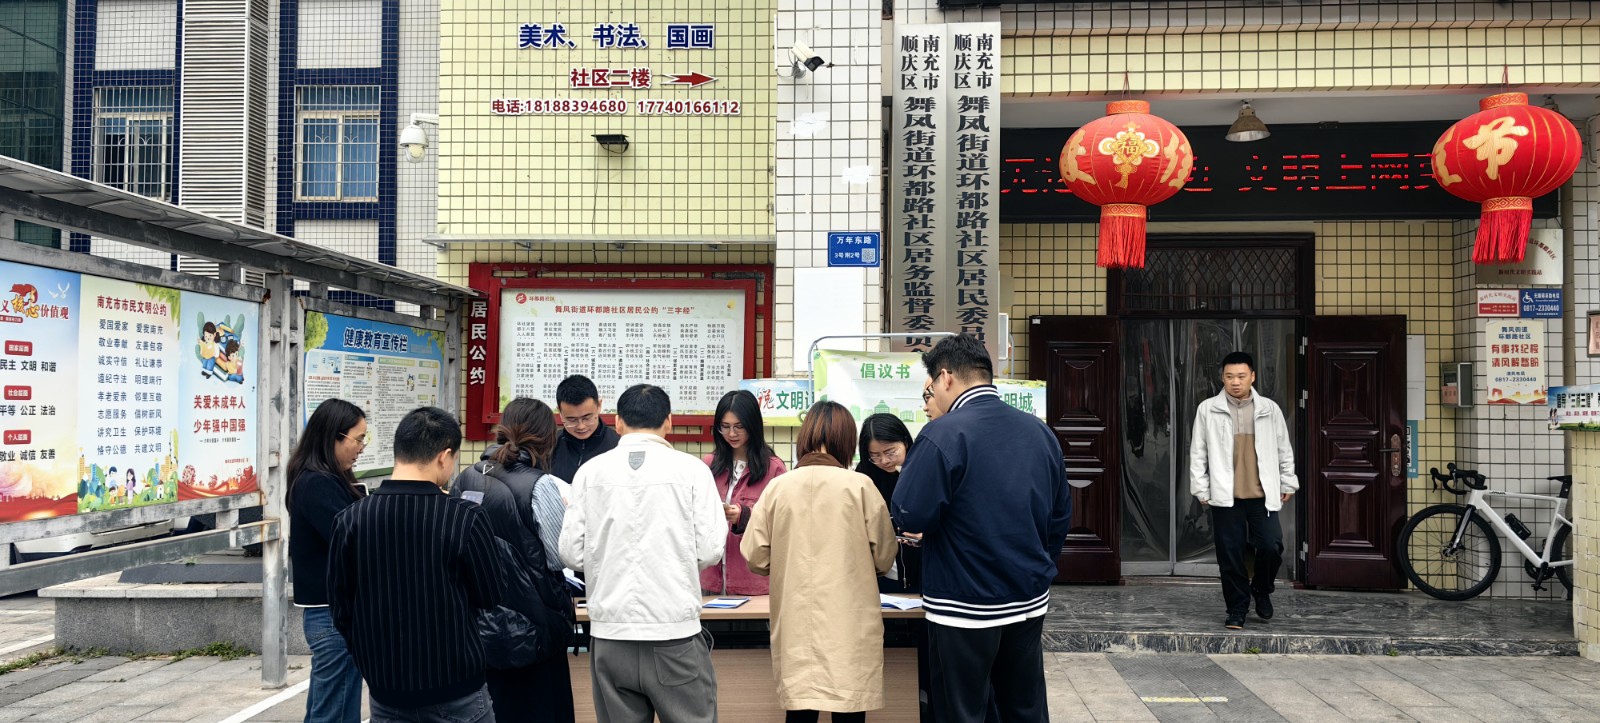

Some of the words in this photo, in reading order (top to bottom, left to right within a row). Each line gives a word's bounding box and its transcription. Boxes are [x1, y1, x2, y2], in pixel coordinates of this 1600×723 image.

[900, 35, 919, 91] 顺庆区
[922, 35, 941, 91] 南充市
[953, 33, 972, 90] 顺庆区
[975, 33, 994, 90] 南充市
[570, 68, 652, 88] 社区二楼
[637, 100, 741, 115] 17740166112
[1118, 139, 1140, 155] 福
[902, 96, 937, 353] 舞凤街道环都路社区居务监督委员
[836, 236, 872, 245] 万年东路
[96, 295, 168, 317] 南充市市民文明公约
[98, 319, 129, 332] 爱国爱家
[135, 322, 164, 335] 爱我南充
[98, 336, 128, 349] 敬业奉献
[135, 339, 163, 352] 友善包容
[344, 326, 408, 353] 健康教育宣传栏
[469, 301, 488, 386] 居民公约
[1491, 343, 1539, 354] 有事找纪检
[0, 359, 16, 371] 民主
[21, 360, 37, 372] 文明
[41, 361, 57, 373] 和谐
[97, 354, 127, 367] 诚实守信
[97, 372, 127, 385] 遵纪守法
[859, 362, 911, 380] 倡议书
[97, 390, 127, 403] 孝老爱亲
[134, 391, 162, 403] 邻里互敬
[193, 394, 246, 411] 关爱未成年人
[999, 391, 1034, 413] 明城
[0, 404, 16, 417] 平等
[20, 404, 37, 416] 公正
[40, 404, 56, 416] 法治
[97, 408, 127, 420] 志愿服务
[97, 426, 127, 438] 讲究卫生
[134, 425, 162, 437] 保护环境
[193, 417, 246, 434] 少年强中国强
[0, 450, 15, 462] 敬业
[20, 449, 36, 461] 诚信
[40, 448, 56, 460] 友善
[134, 442, 162, 455] 共建文明
